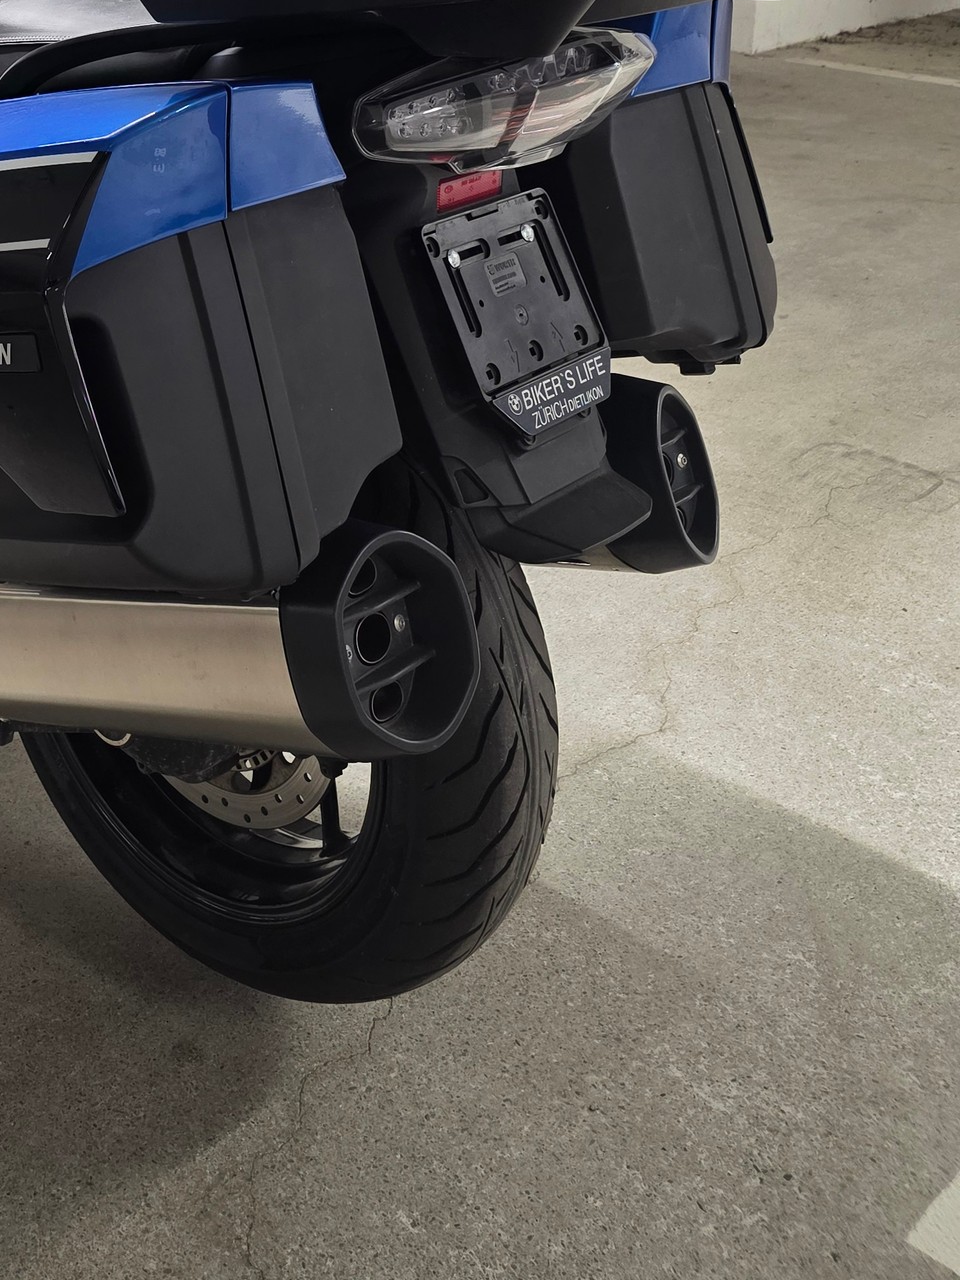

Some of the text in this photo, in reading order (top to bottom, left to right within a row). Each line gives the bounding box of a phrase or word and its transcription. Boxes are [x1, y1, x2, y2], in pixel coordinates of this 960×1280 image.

[576, 355, 606, 384] LIFE
[531, 385, 604, 429] ZÜRICH DIETLIKON
